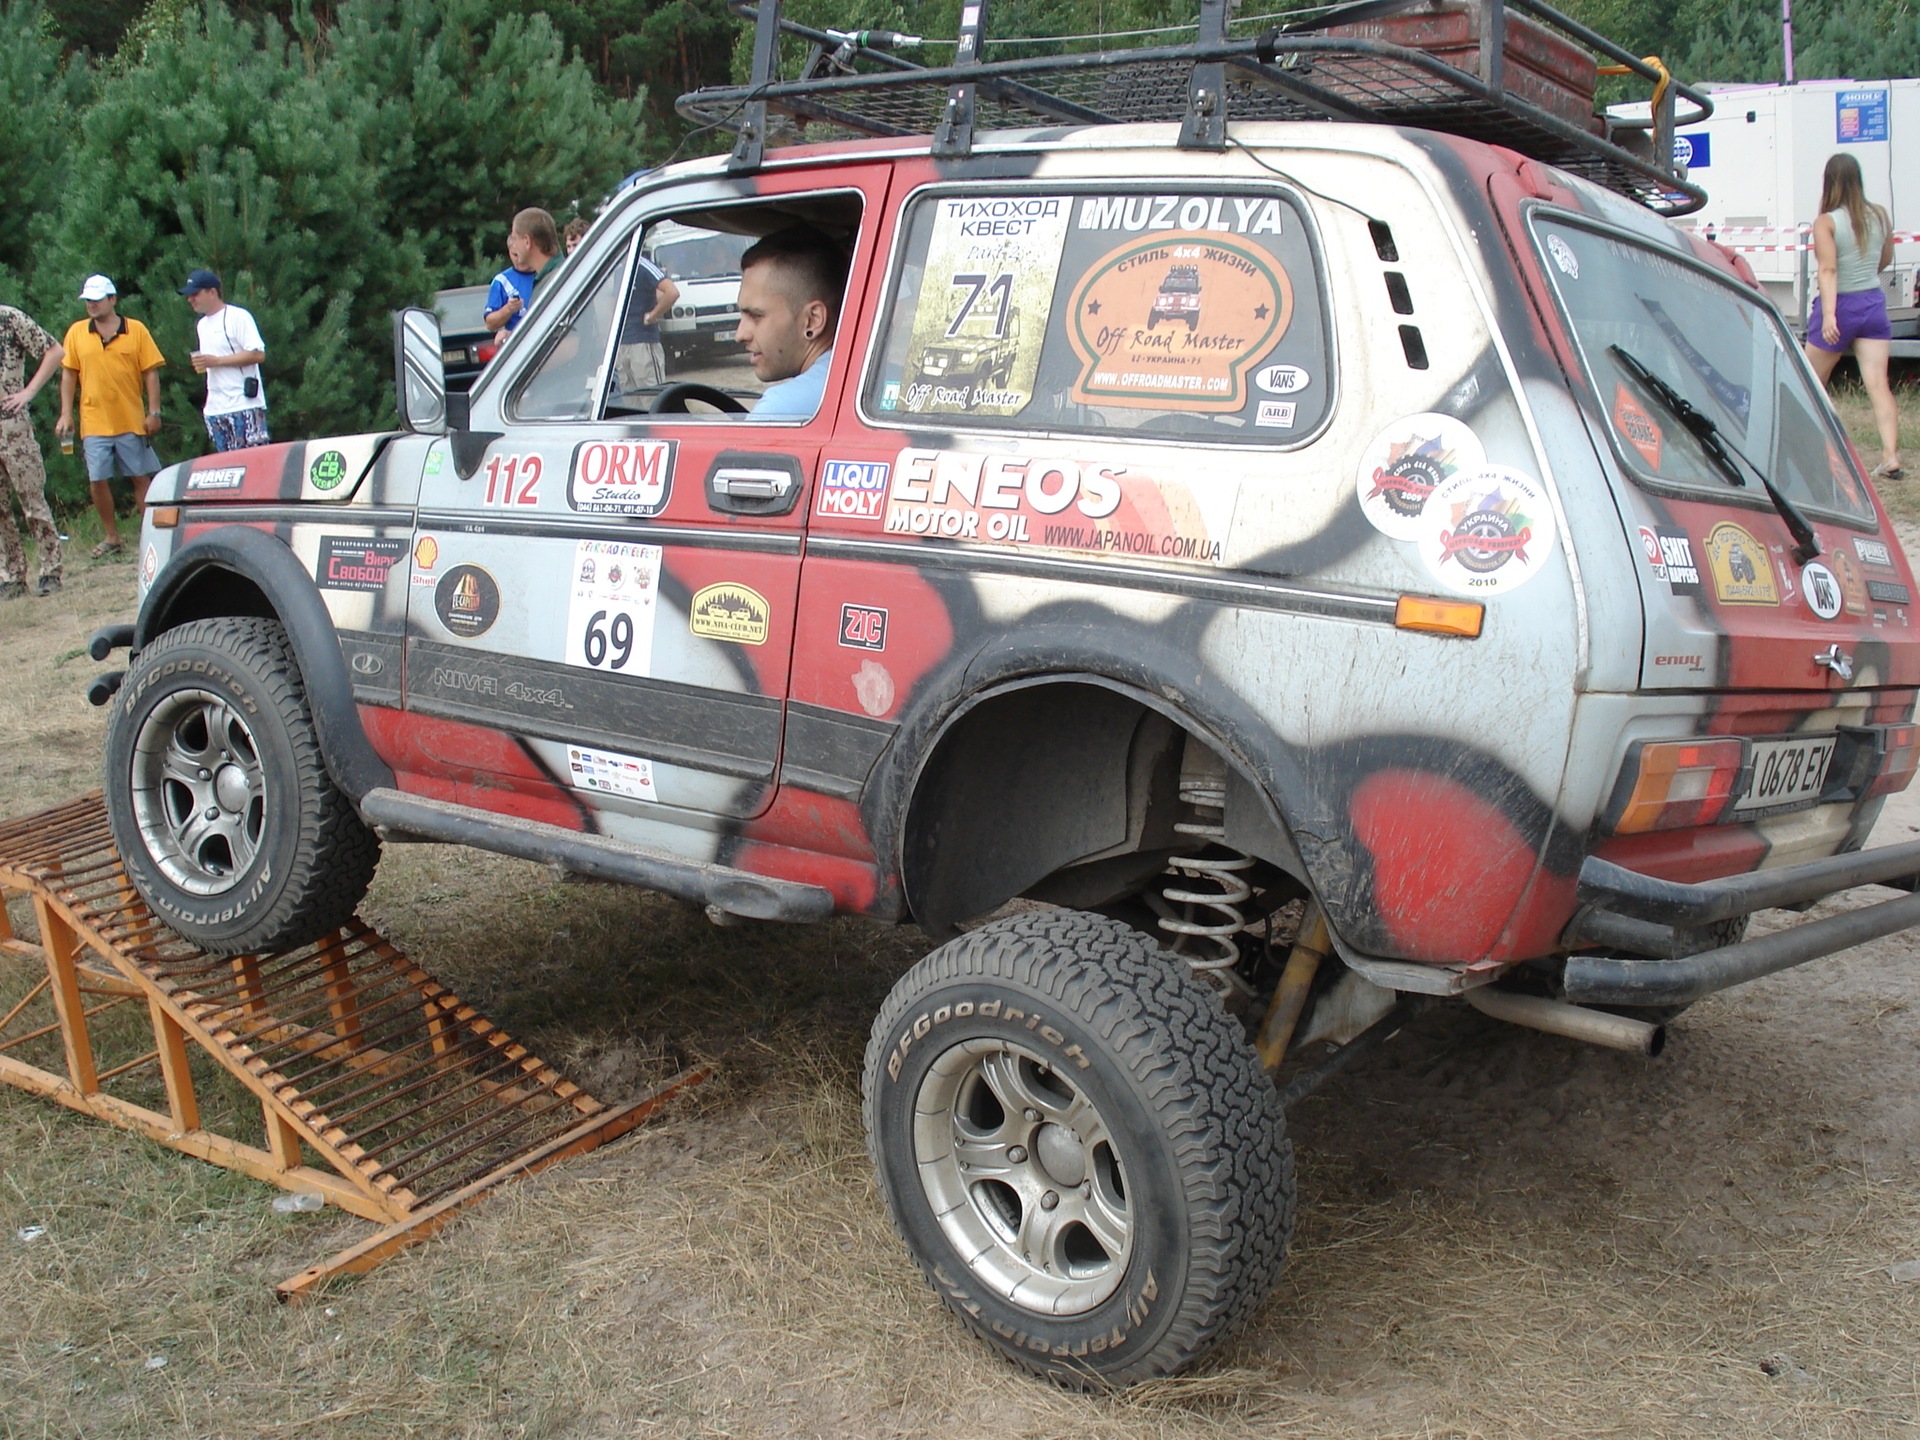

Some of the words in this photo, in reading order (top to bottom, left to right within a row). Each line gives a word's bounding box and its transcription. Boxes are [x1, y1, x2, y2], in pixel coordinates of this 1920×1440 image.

[947, 200, 1060, 218] ТИХОХОД
[960, 219, 1037, 236] КВЕСТ
[1118, 248, 1169, 273] СТИЛЬ
[1203, 247, 1258, 278] ЖИЗНИ
[944, 273, 1014, 339] 71
[1097, 326, 1127, 355] Off
[1130, 329, 1176, 353] Road
[1181, 328, 1245, 350] Master
[1094, 372, 1228, 391] WWW.OFFROADMASTER.COM
[1270, 370, 1296, 389] VANS
[906, 383, 932, 410] Off
[931, 385, 969, 409] Road
[971, 386, 1022, 405] Master
[1265, 407, 1289, 418] ARB
[186, 467, 246, 489] PLANET
[317, 462, 339, 477] CB
[581, 444, 665, 486] ORM
[826, 463, 886, 490] LIQUI
[486, 455, 542, 505] 112
[592, 487, 641, 501] Studio
[892, 448, 1127, 518] ENEOS
[1441, 477, 1472, 499] СТИЛЬ
[1502, 474, 1536, 499] ЖИЗНИ
[821, 489, 883, 517] MOLY
[1401, 491, 1422, 502] 2009
[888, 507, 979, 539] MOTOR
[987, 513, 1031, 542] OIL
[1460, 514, 1509, 532] УКРАИНА
[1044, 525, 1221, 562] WWW.JAPANOIL.COM.UA
[1659, 536, 1694, 567] SHIT
[413, 575, 436, 586] Shell
[1468, 578, 1497, 587] 2010
[1667, 566, 1700, 584] HAPPENS
[1808, 570, 1835, 610] VANS
[584, 609, 634, 670] 69
[845, 609, 882, 643] ZIC
[1655, 655, 1703, 668] envy
[125, 659, 258, 716] BFGoodrich
[434, 667, 498, 695] NIVA
[505, 682, 565, 707] 4x4
[1759, 748, 1804, 797] 0678
[1801, 745, 1832, 791] EX
[158, 857, 272, 926] All-Terrain
[887, 999, 1091, 1083] BFGoodrich
[991, 1267, 1160, 1357] All-Terrain
